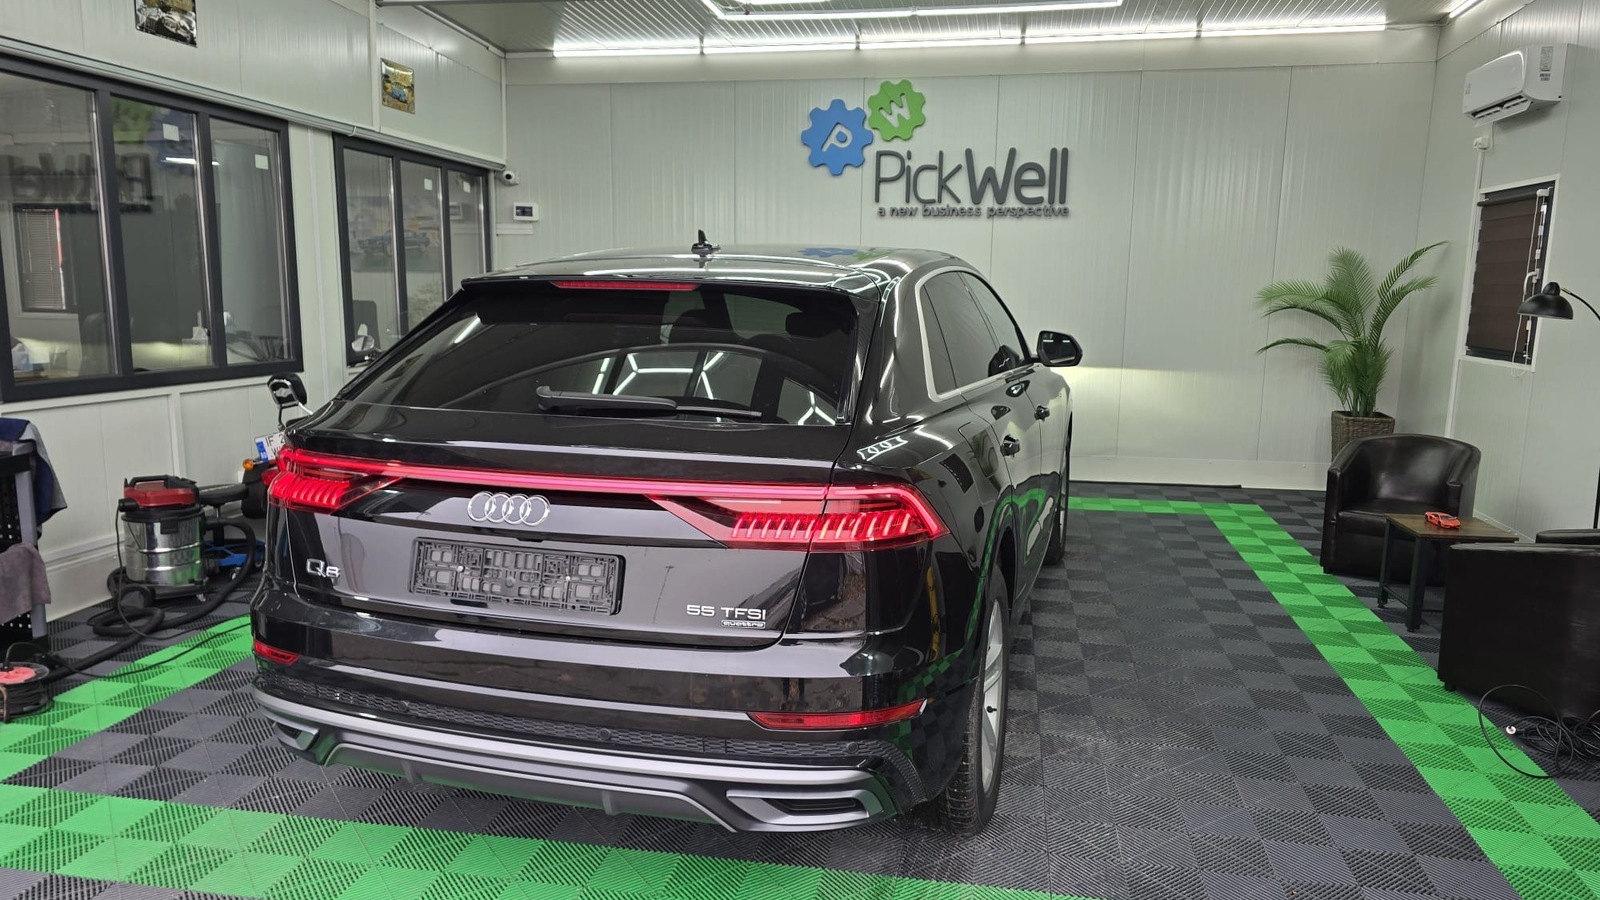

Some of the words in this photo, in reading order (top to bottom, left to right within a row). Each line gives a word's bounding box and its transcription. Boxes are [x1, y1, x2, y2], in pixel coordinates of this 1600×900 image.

[875, 148, 1069, 205] PickWell
[878, 206, 886, 216] a
[890, 206, 918, 217] new
[922, 203, 981, 217] business
[987, 204, 1069, 219] perspective
[306, 558, 340, 578] Q8
[686, 604, 715, 617] 55
[721, 607, 766, 621] TFSI
